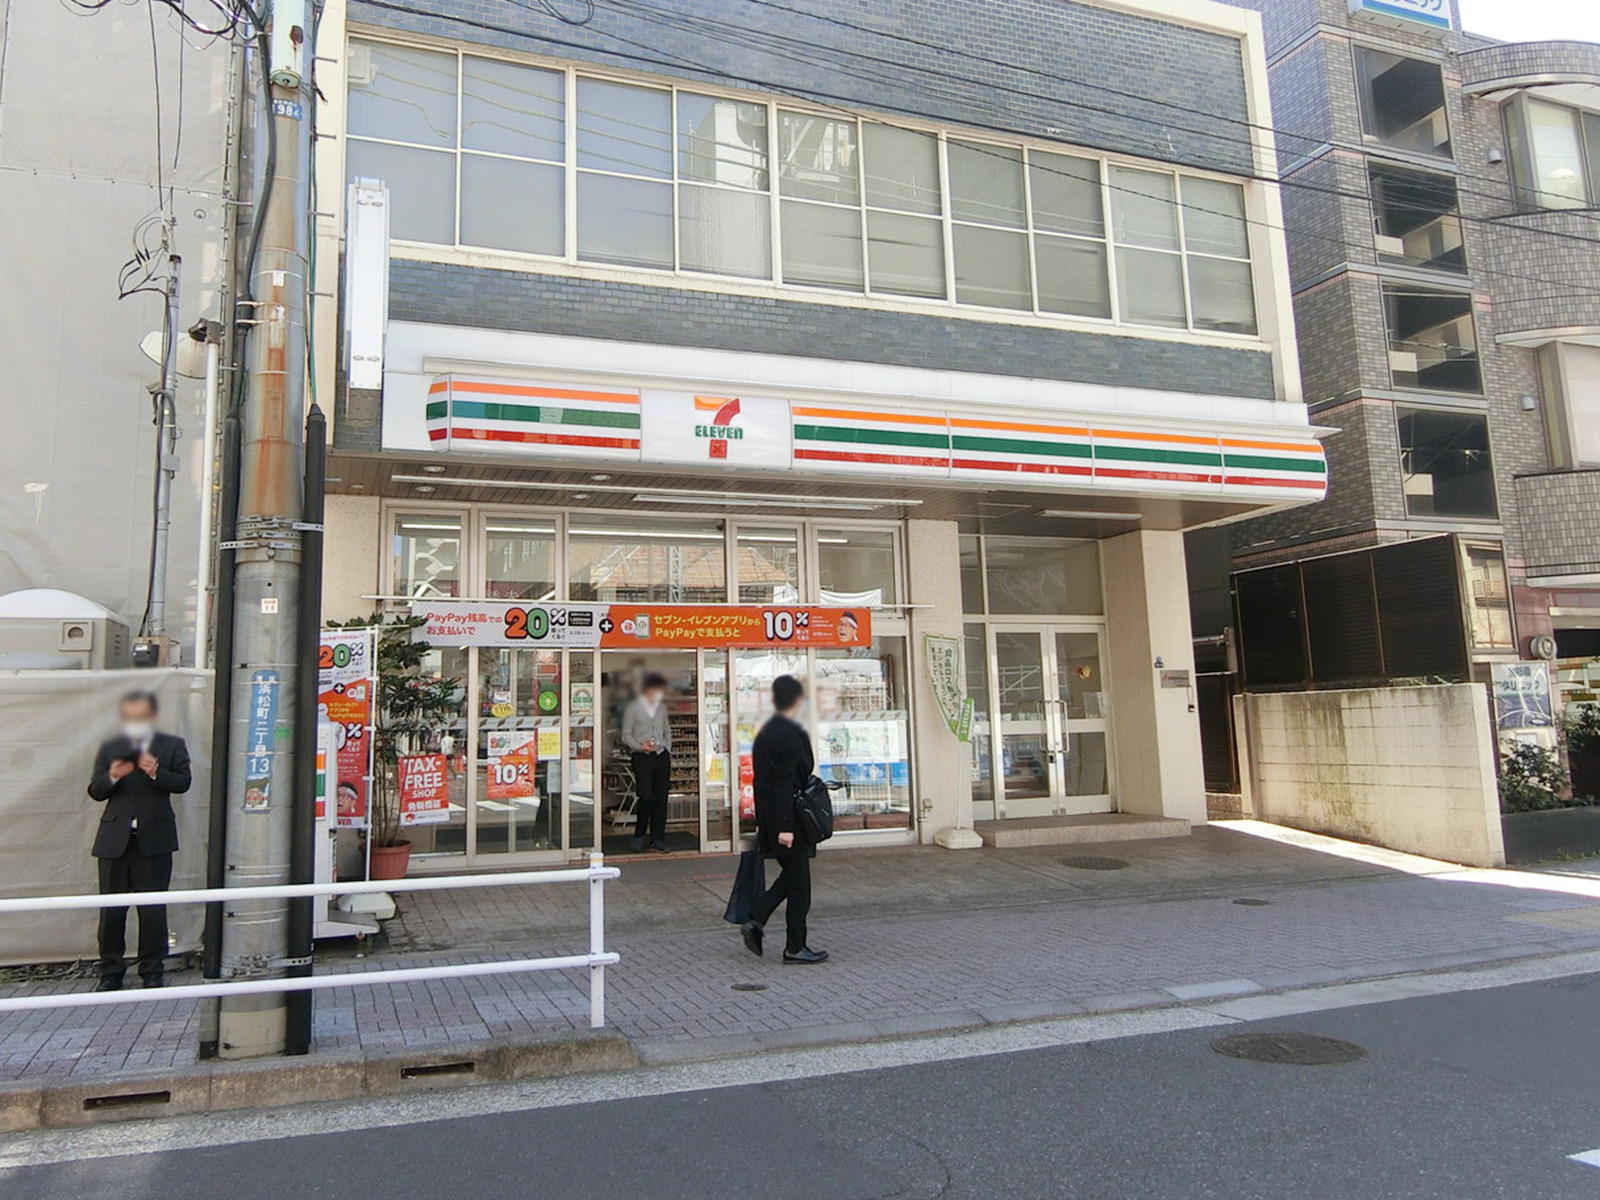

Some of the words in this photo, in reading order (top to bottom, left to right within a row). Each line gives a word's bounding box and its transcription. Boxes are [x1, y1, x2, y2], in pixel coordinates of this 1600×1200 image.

[426, 625, 476, 636] お支払いで
[655, 627, 741, 639] PayPayで支払うと
[762, 610, 809, 640] 10%
[249, 757, 270, 773] 13
[403, 756, 441, 774] TAX-
[404, 771, 443, 790] FREE
[412, 787, 437, 799] SHOP
